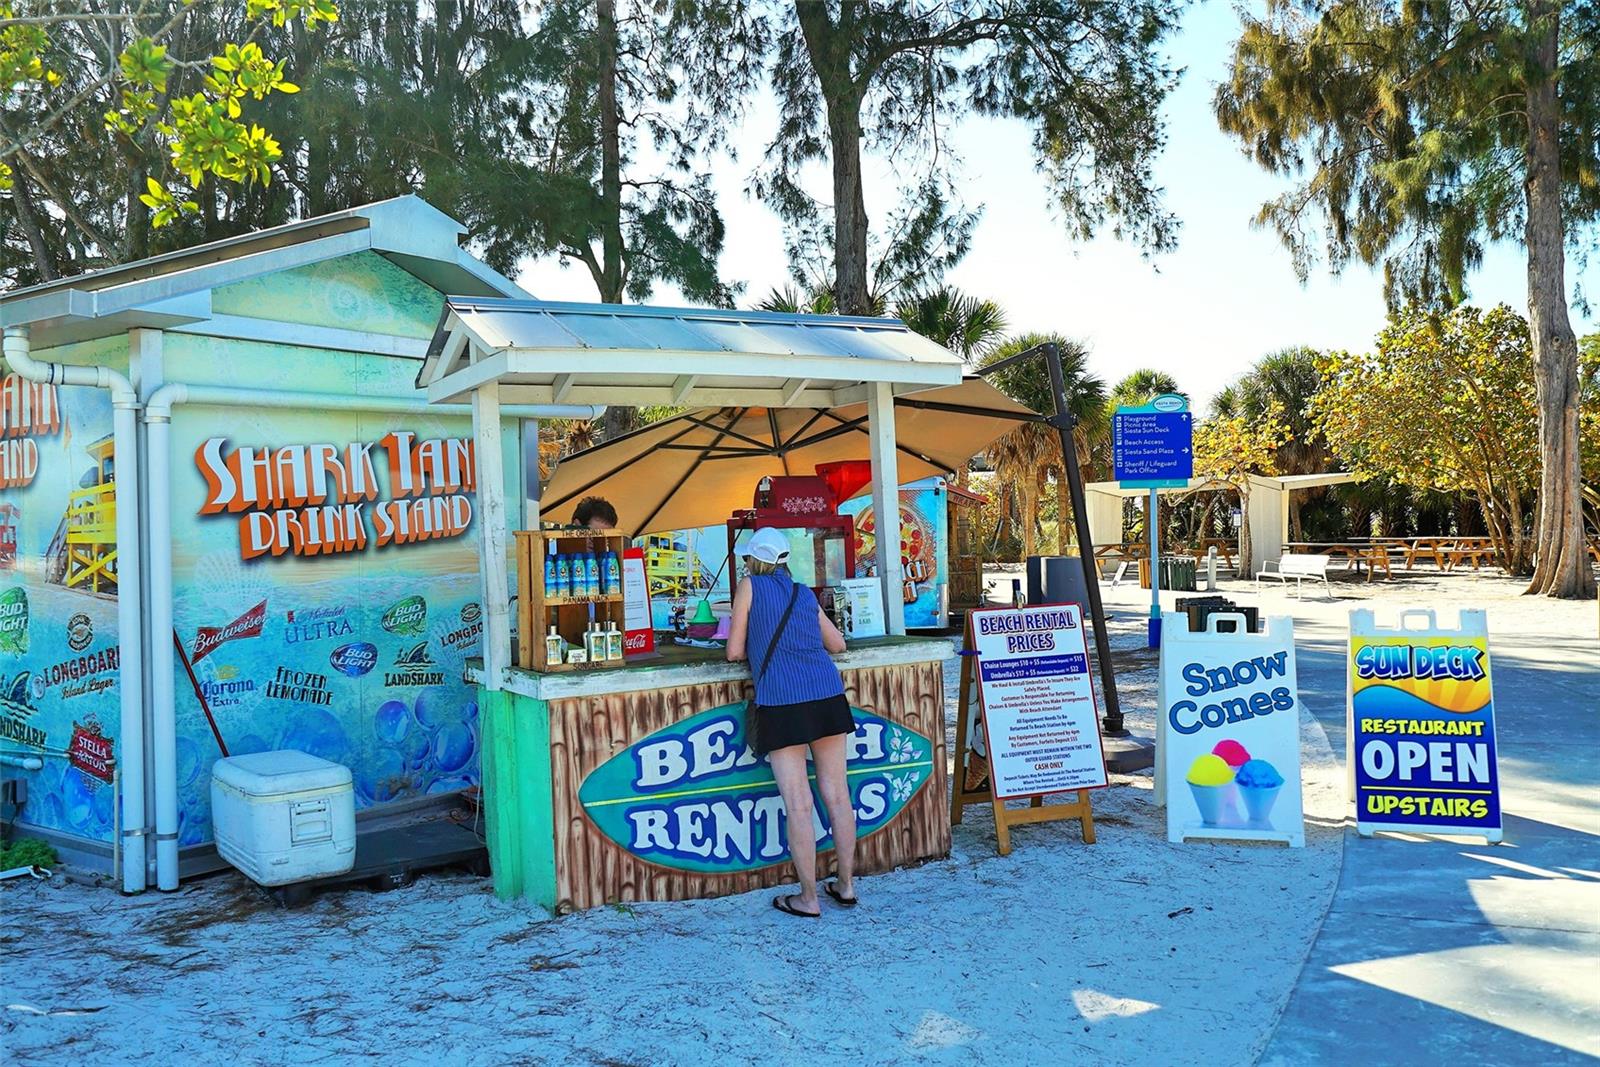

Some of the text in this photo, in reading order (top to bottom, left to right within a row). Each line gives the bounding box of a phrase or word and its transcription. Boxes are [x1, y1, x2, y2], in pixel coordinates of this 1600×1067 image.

[1124, 415, 1156, 423] Playground
[196, 431, 476, 512] SHARK TAN
[1149, 460, 1178, 468] Lifeguard
[239, 495, 472, 560] DRINK STAND
[562, 595, 590, 604] PANAMA
[389, 610, 425, 627] LIGHT
[979, 612, 1077, 634] BEACH RENTAL
[186, 613, 267, 653] Budweiser
[284, 618, 354, 644] ULTRA
[1007, 633, 1056, 652] PRICES
[338, 656, 376, 668] LIGHT
[1000, 661, 1020, 669] Lounges
[1181, 650, 1288, 697] Snow
[1356, 645, 1486, 681] SUN DECK
[61, 677, 114, 700] Island Lager
[276, 665, 328, 689] FROZEN
[384, 671, 445, 688] LANDSHARK
[199, 680, 255, 702] Corona
[212, 696, 240, 708] Extra
[265, 680, 334, 706] LEMONADE
[1168, 687, 1294, 735] Cones
[1361, 718, 1485, 736] RESTAURANT
[78, 736, 107, 759] STELLA
[635, 719, 884, 787] BEH
[1361, 739, 1491, 784] OPEN
[1367, 795, 1489, 819] UPSTAIRS
[628, 782, 887, 861] RENTS
